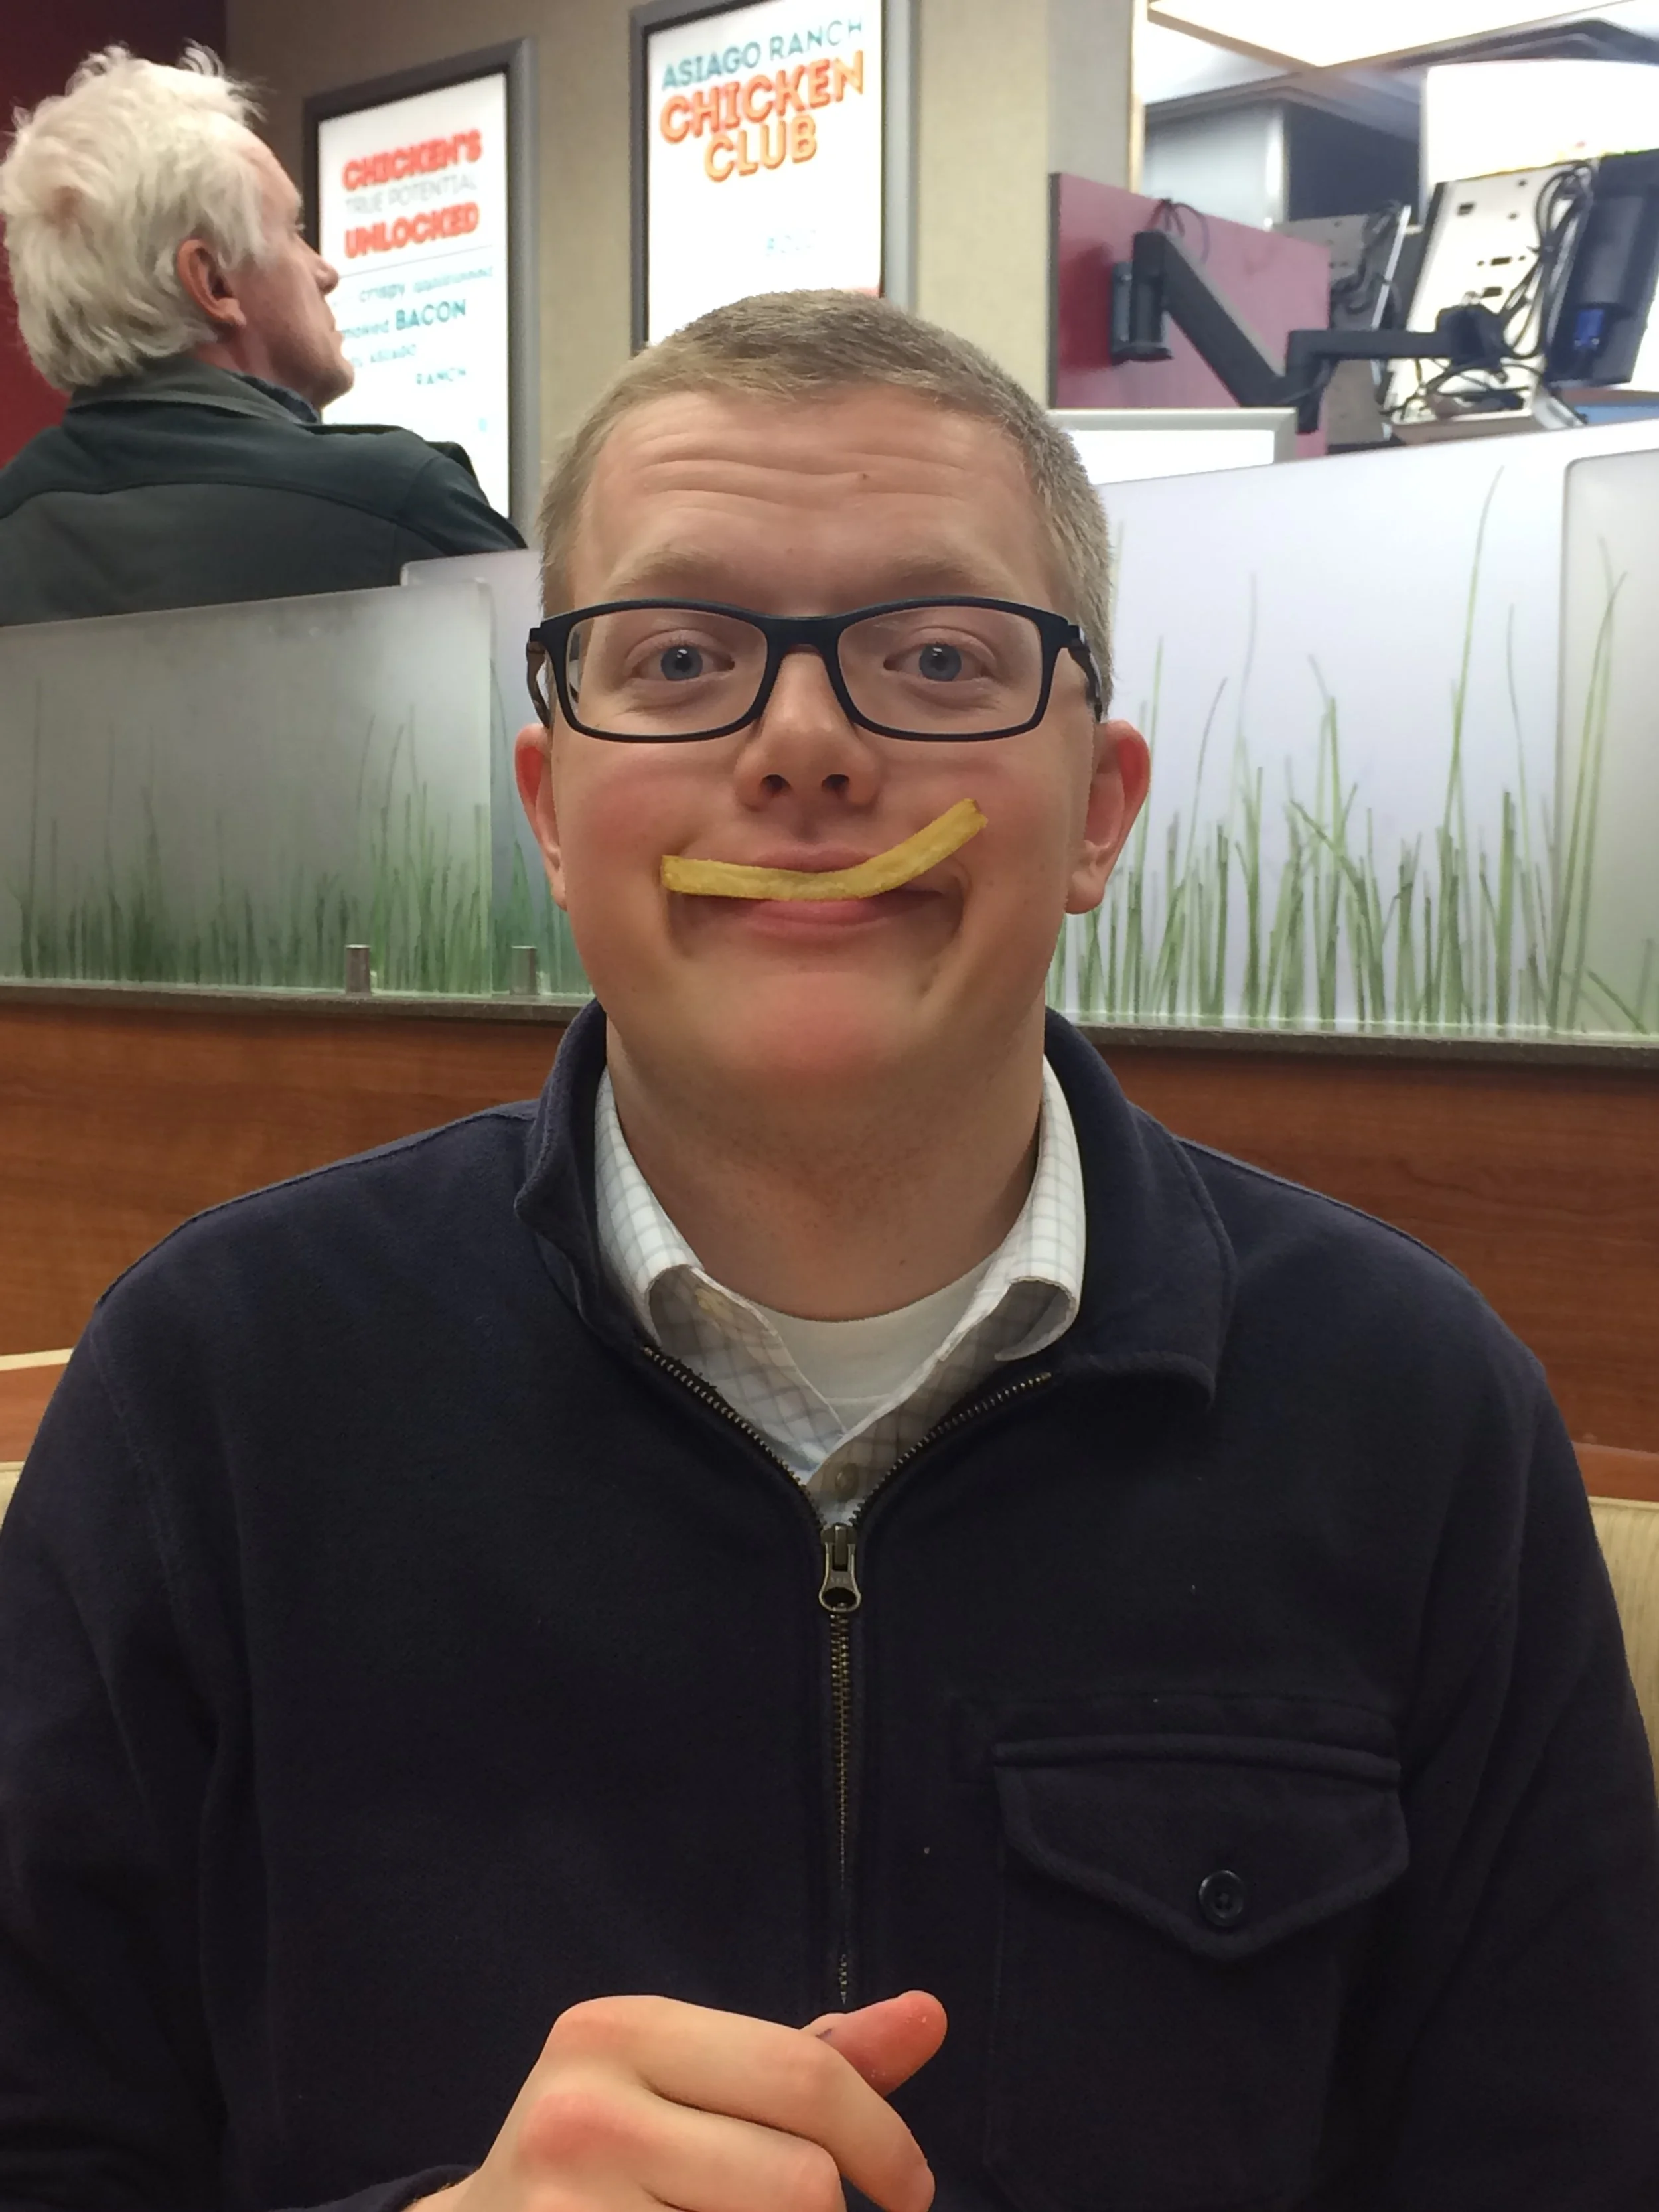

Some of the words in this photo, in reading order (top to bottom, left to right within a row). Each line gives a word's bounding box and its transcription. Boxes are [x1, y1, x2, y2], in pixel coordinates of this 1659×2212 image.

[661, 42, 762, 90] ASIAGO
[769, 17, 862, 61] RANCH
[660, 50, 864, 144] CHICKEN
[342, 129, 482, 192] CHICKEN'S
[705, 115, 817, 183] CLUB
[344, 200, 480, 259] UNLOCKED
[396, 298, 466, 331] BACON
[416, 366, 466, 386] RANCH
